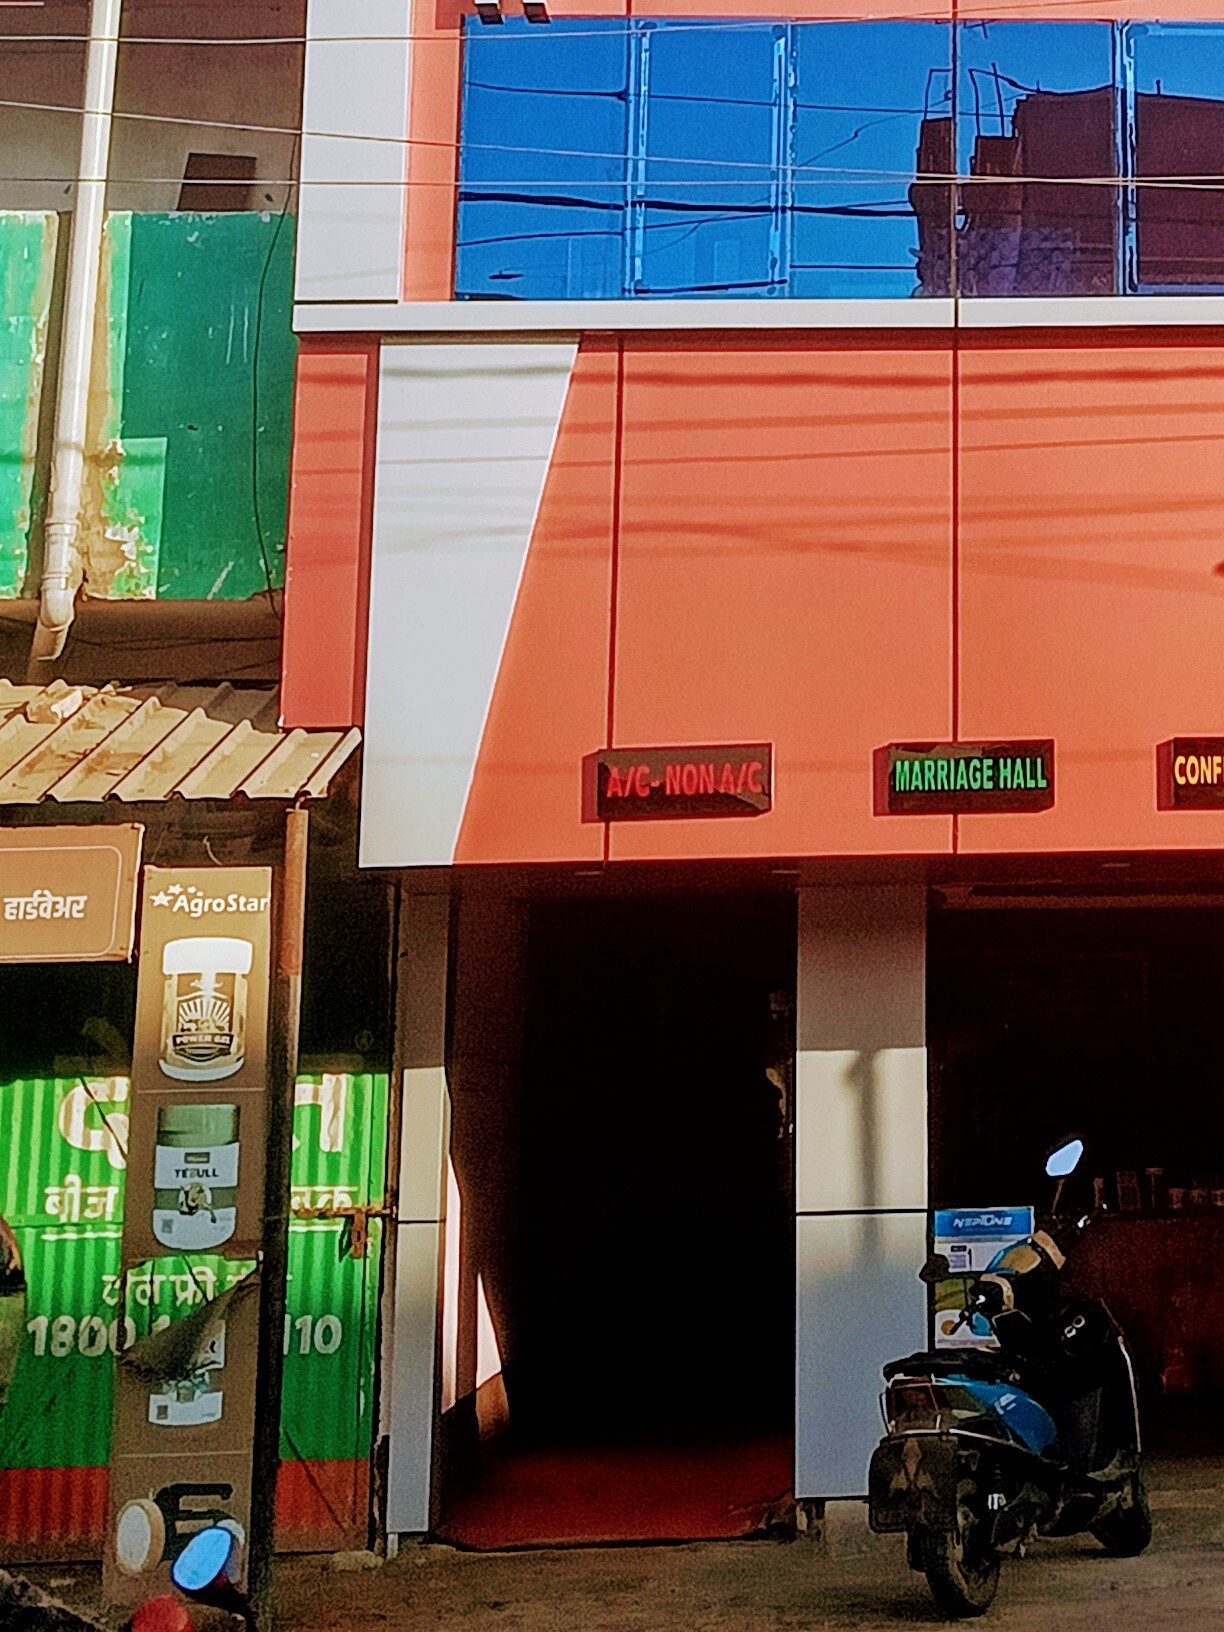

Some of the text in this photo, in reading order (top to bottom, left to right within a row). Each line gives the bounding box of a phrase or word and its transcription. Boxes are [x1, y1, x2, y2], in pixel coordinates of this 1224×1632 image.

[721, 761, 763, 792] A/C
[895, 754, 1048, 791] MARRIAGE HALL
[4, 889, 88, 920] हार्डवेअर
[173, 894, 270, 917] AgroStar
[953, 1215, 1012, 1227] NEPTUNE
[27, 1315, 136, 1357] 1800
